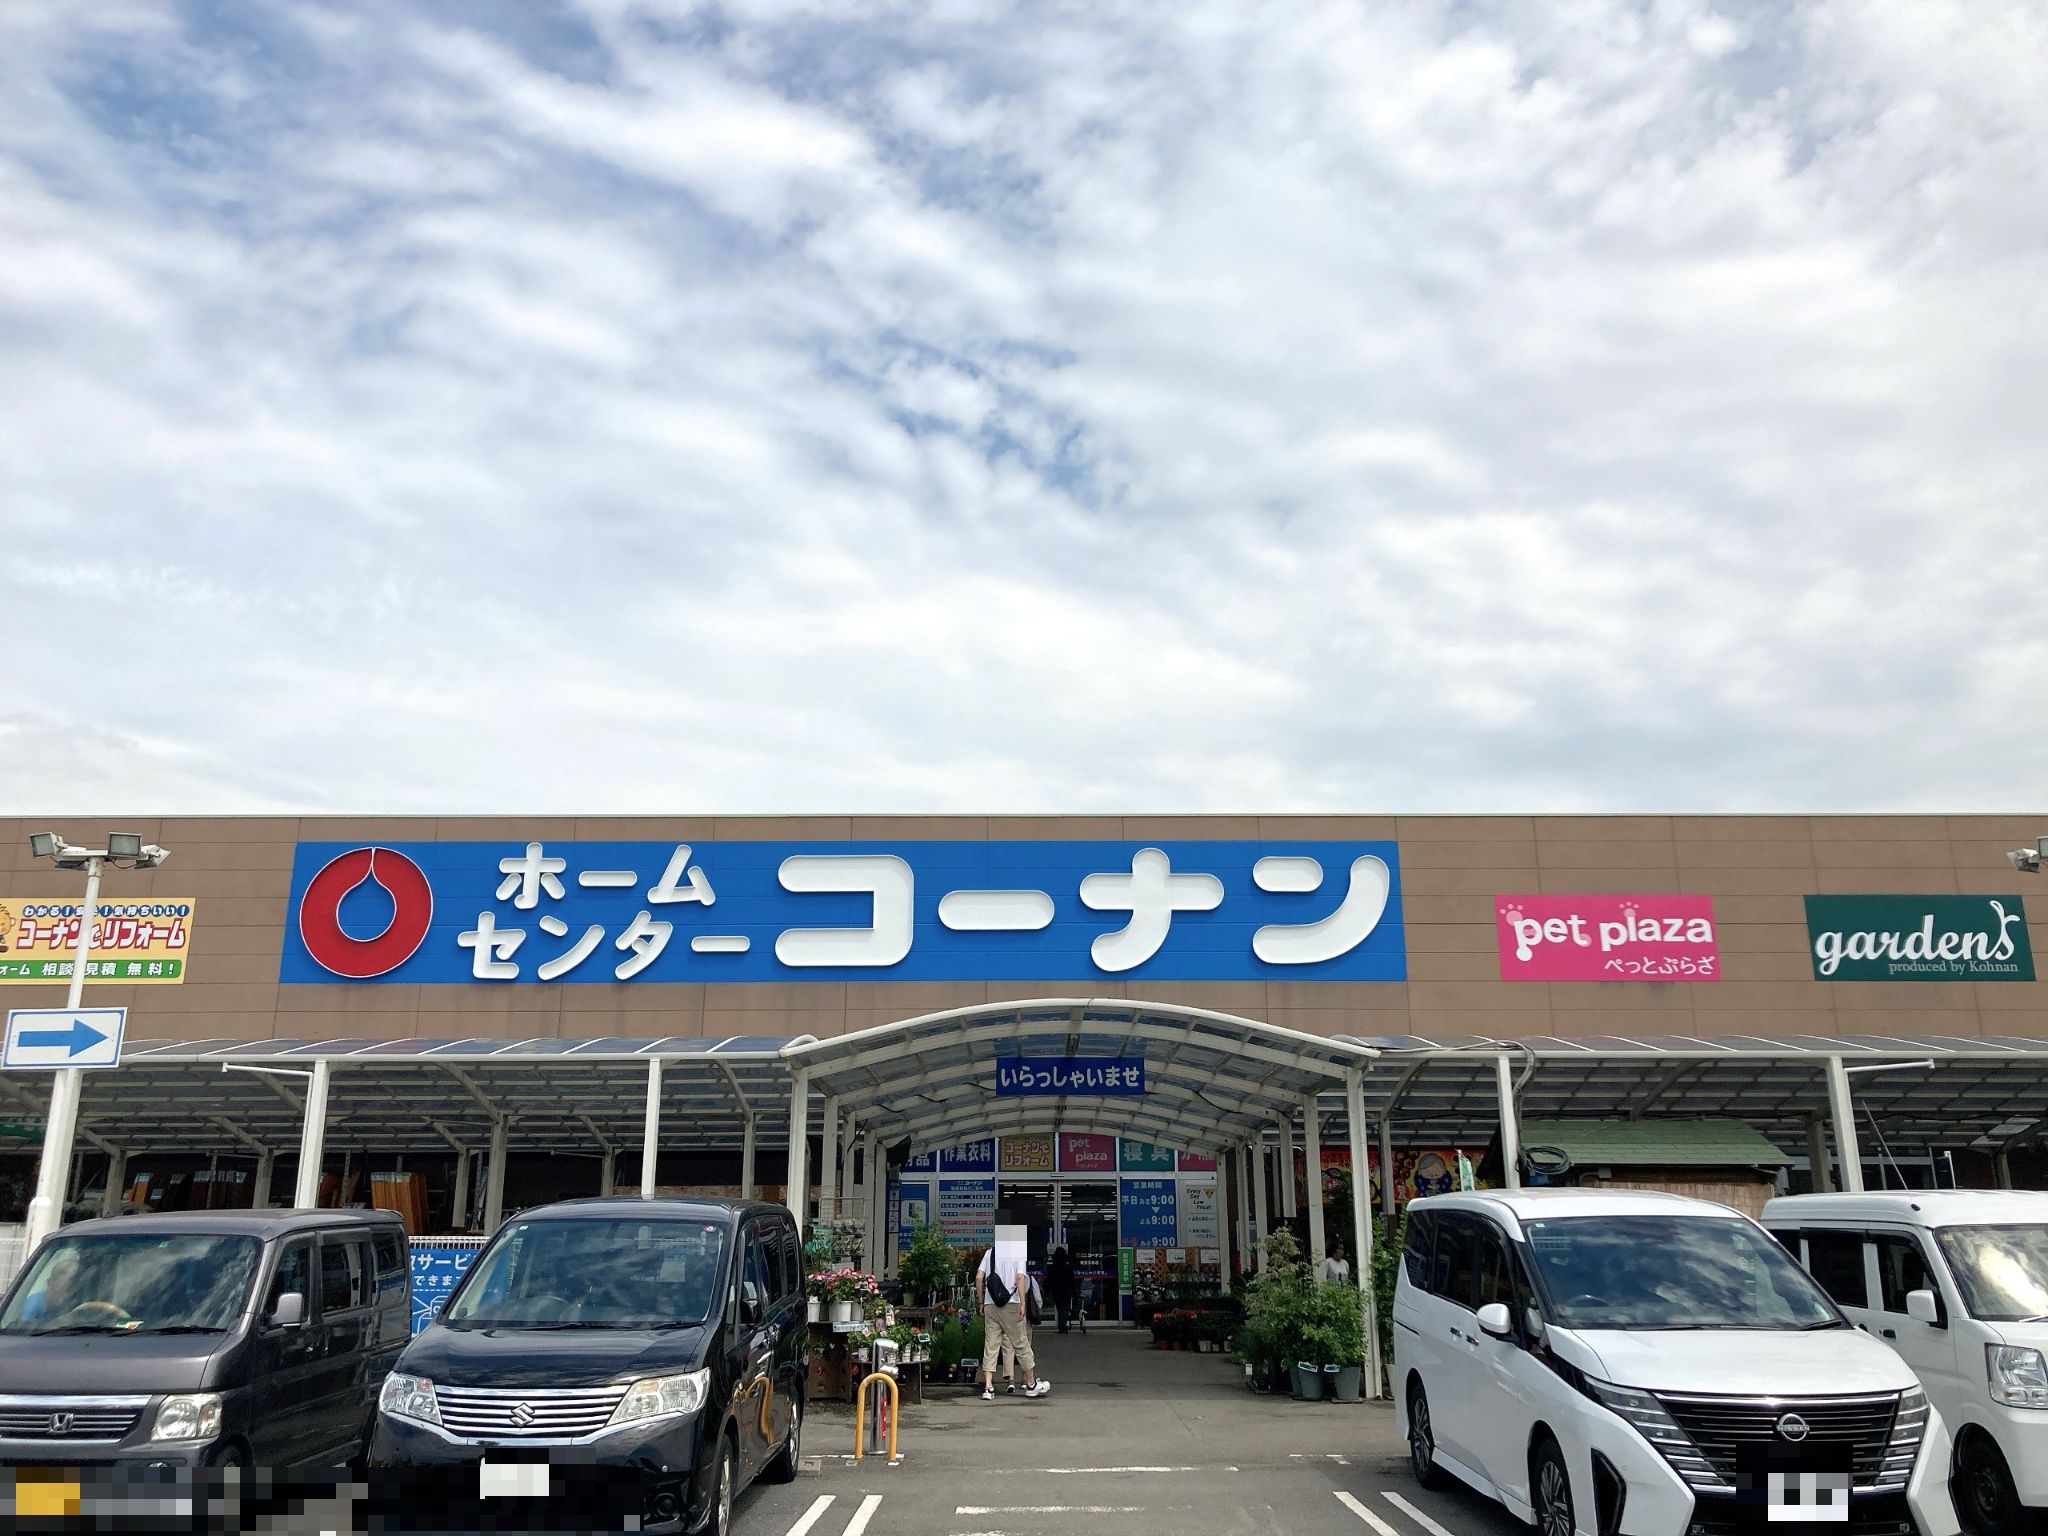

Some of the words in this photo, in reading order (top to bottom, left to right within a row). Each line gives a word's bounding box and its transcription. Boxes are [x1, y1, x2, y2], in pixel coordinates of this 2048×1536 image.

[496, 842, 716, 909] ホーム
[24, 905, 190, 917] わかる！安！気持ちいい！
[774, 847, 1390, 972] コーナン
[457, 910, 750, 980] センター
[1513, 914, 1588, 961] pet
[1599, 916, 1714, 951] plaza
[1815, 900, 2021, 976] gardens
[1604, 955, 1716, 975] ぺっとぷらざ
[1888, 960, 1947, 975] produced
[1950, 960, 1966, 976] by
[1969, 960, 2019, 973] Kohnan
[1001, 1065, 1140, 1089] いらっしゃいませ
[1075, 1151, 1108, 1164] plaza
[411, 1253, 477, 1271] サービ
